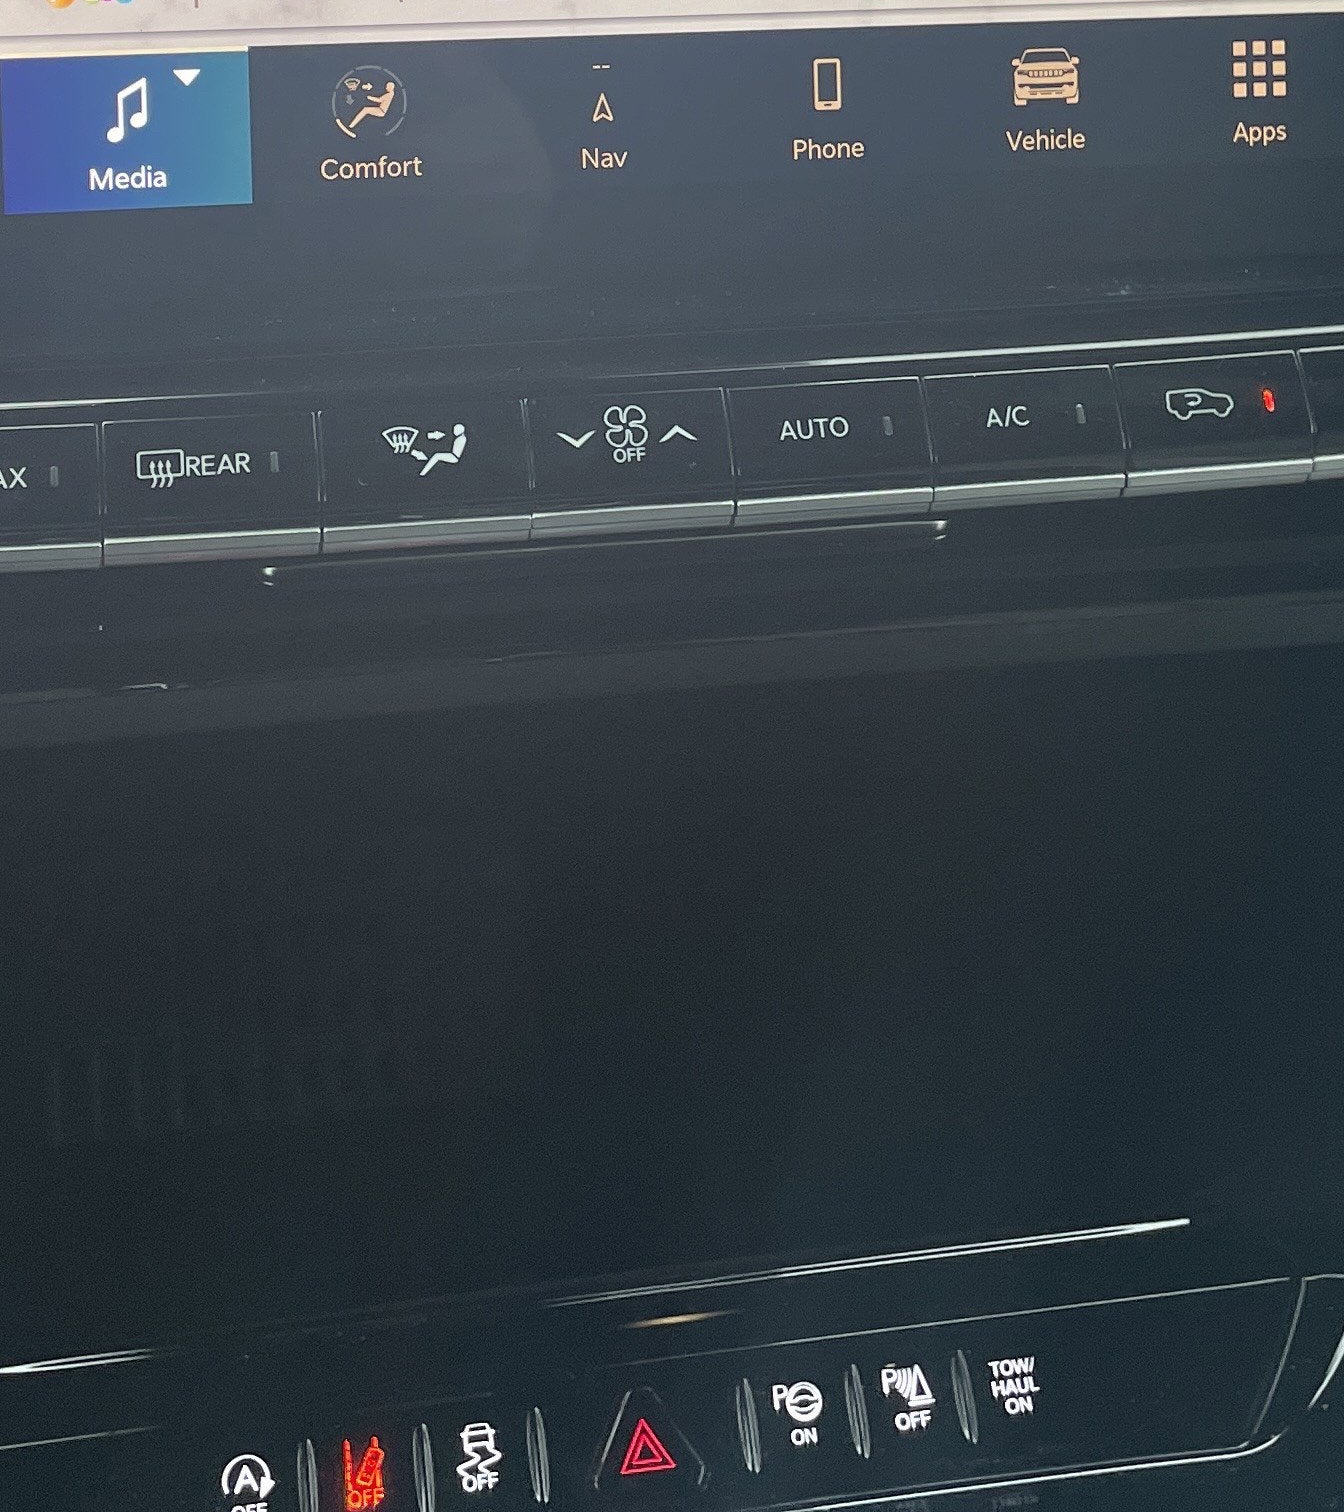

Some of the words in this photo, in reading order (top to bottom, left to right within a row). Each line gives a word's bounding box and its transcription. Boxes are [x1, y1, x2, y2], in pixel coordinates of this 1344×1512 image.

[1004, 128, 1086, 152] Vehicle
[1232, 121, 1288, 147] Apps
[581, 147, 628, 170] Nav
[792, 138, 865, 161] Phone
[88, 165, 168, 192] Media
[319, 155, 423, 181] Comfort
[779, 416, 849, 441] AUTO
[985, 405, 1031, 429] A/C
[184, 451, 251, 477] REAR
[612, 447, 647, 464] OFF
[987, 1356, 1035, 1378] TOW/
[990, 1374, 1041, 1399] HAUL
[1004, 1396, 1034, 1416] ON
[894, 1409, 932, 1432] OFF
[790, 1427, 819, 1446] ON
[462, 1471, 499, 1493] OFF
[347, 1487, 385, 1510] OFF
